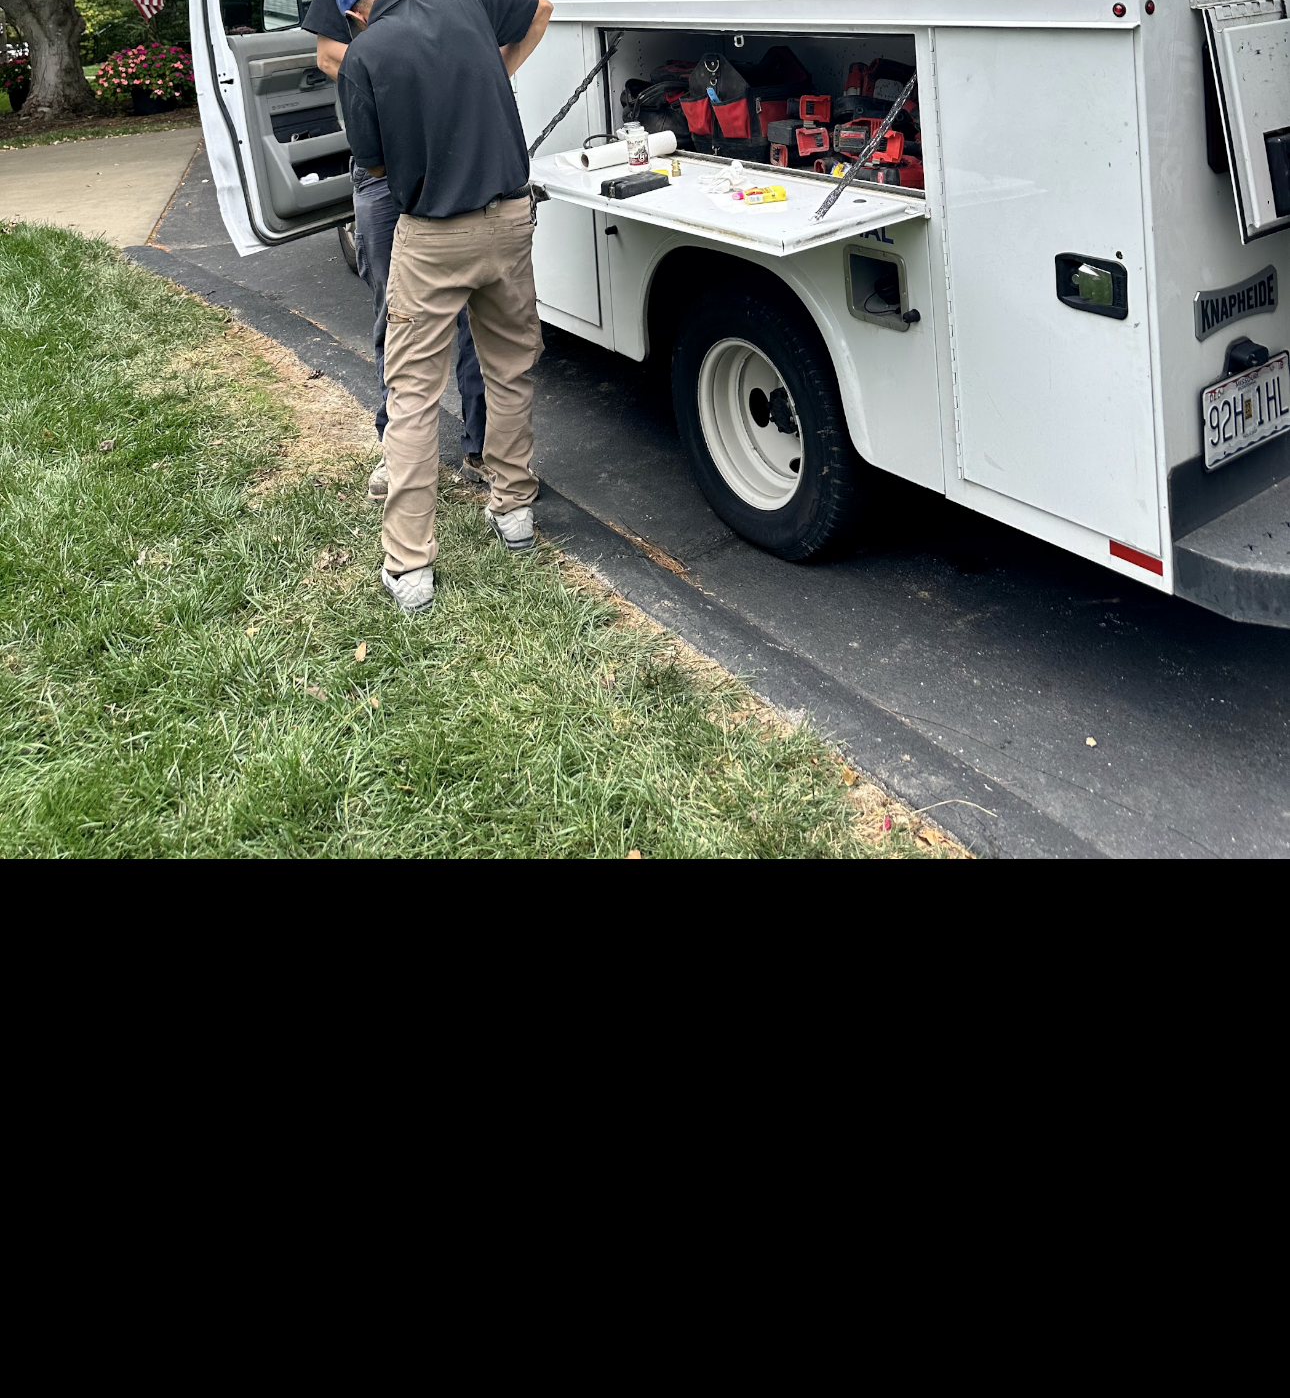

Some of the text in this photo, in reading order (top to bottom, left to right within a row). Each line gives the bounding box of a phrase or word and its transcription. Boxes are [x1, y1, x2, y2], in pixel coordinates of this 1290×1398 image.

[1200, 273, 1275, 334] KNAPHEIDE
[1208, 376, 1290, 447] 92H 1HL
